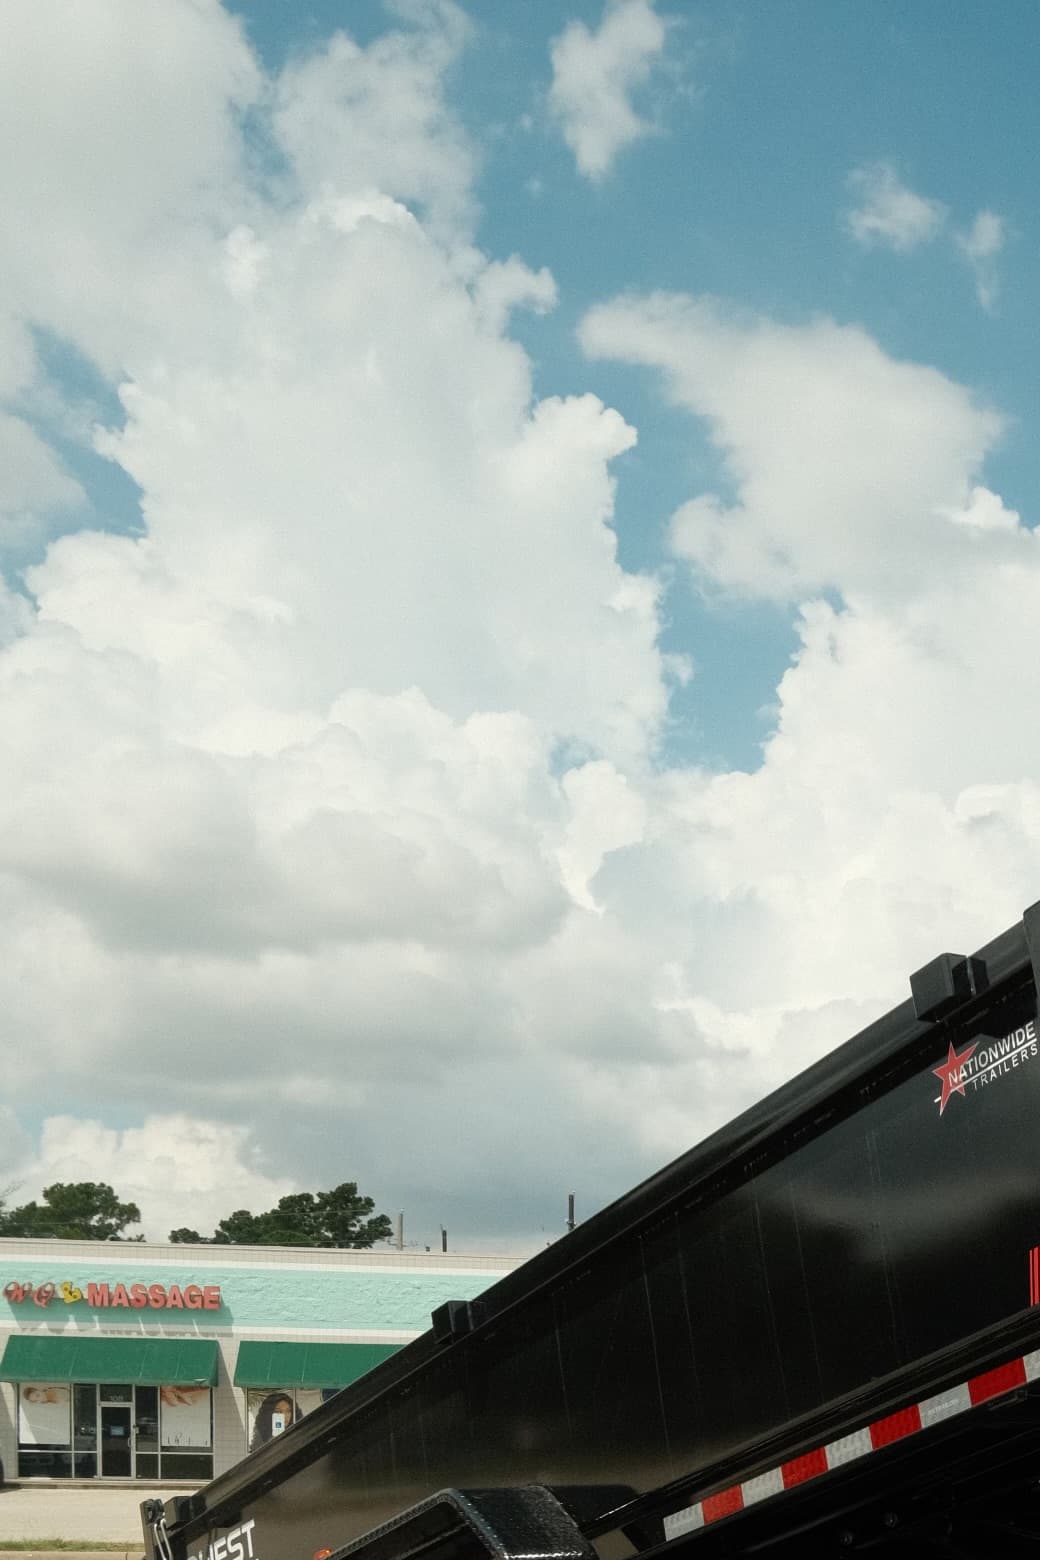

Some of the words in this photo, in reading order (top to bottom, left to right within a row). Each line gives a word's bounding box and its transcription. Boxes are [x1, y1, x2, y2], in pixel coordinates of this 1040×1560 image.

[948, 1020, 1036, 1087] NATIONWIDE
[972, 1043, 1038, 1091] TRAILERS
[87, 1282, 221, 1311] MASSAGE
